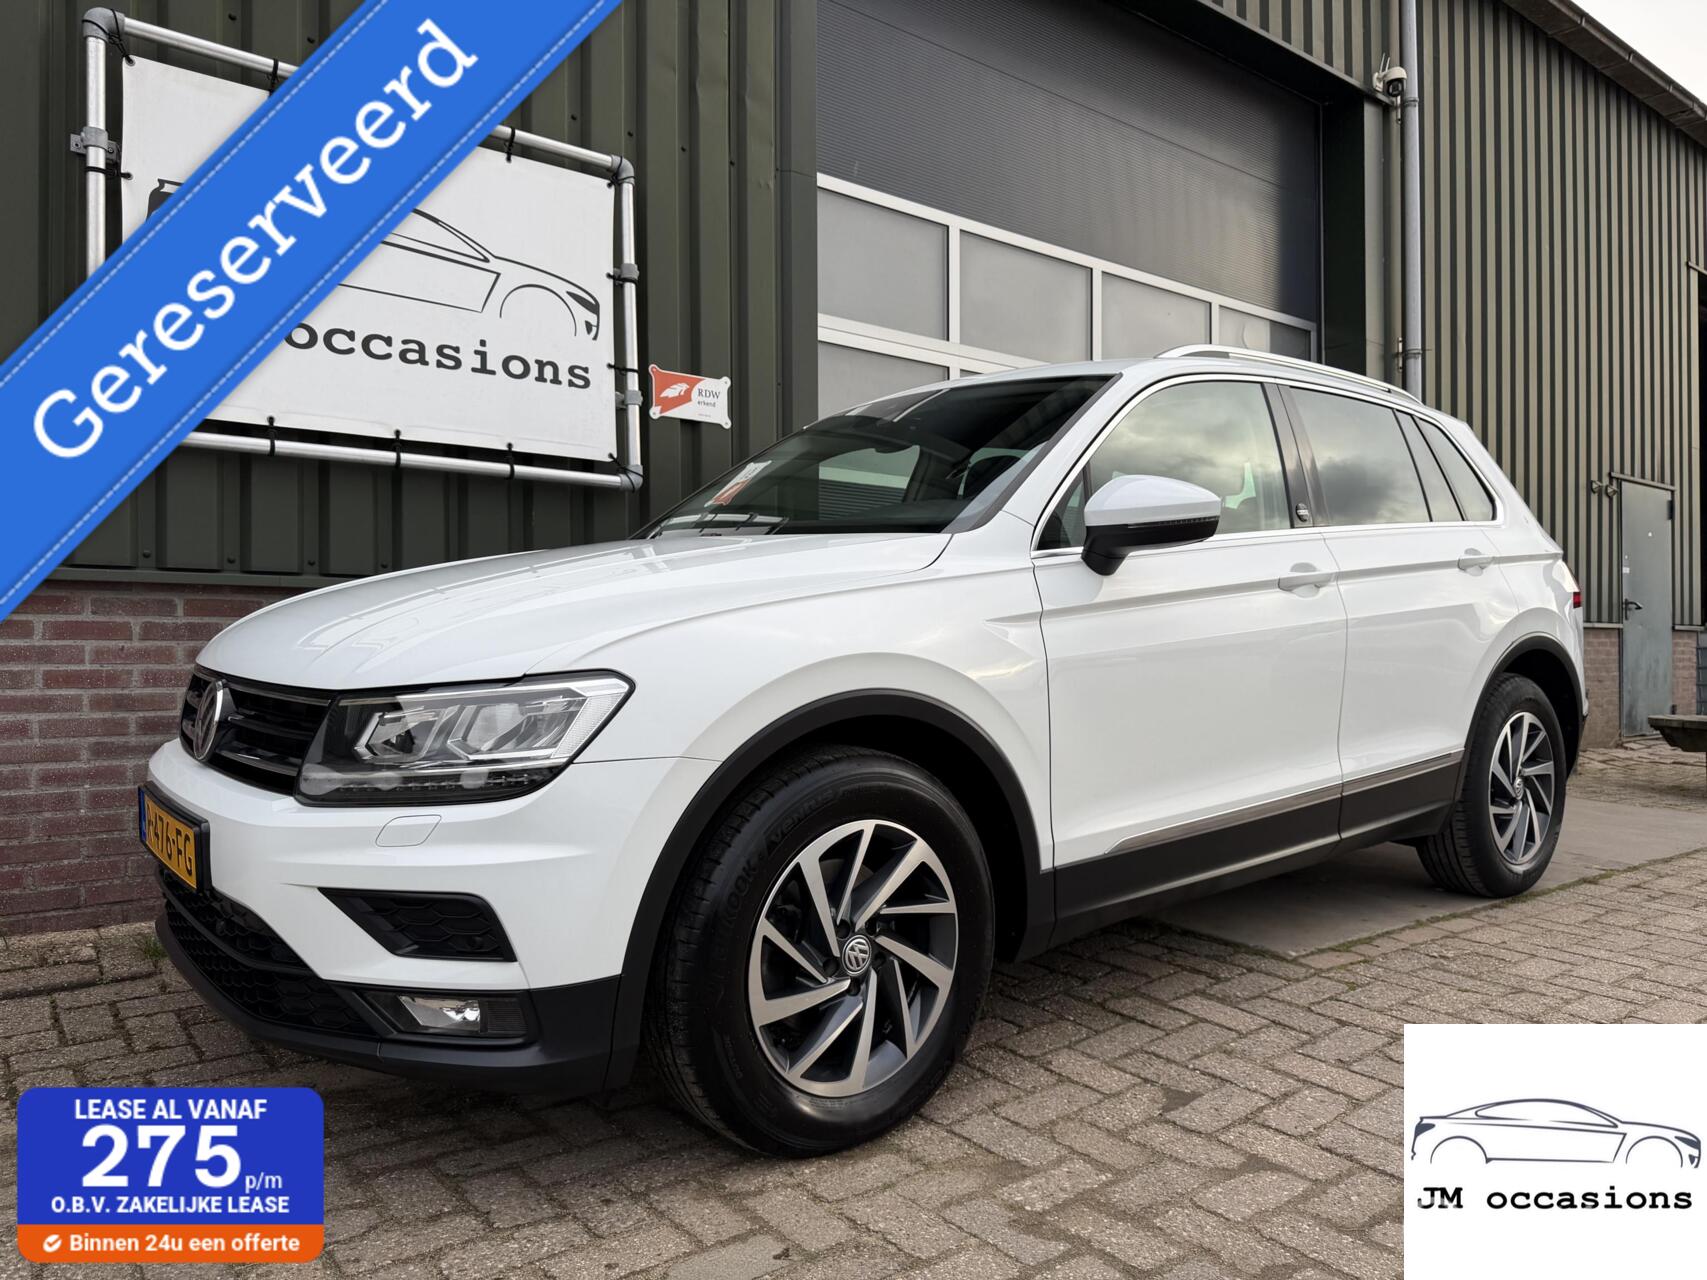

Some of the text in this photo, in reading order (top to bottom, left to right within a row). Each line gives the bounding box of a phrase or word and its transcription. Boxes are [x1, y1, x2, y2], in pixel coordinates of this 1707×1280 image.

[284, 322, 591, 389] occasions
[697, 388, 721, 399] RDW
[697, 400, 716, 408] erkend
